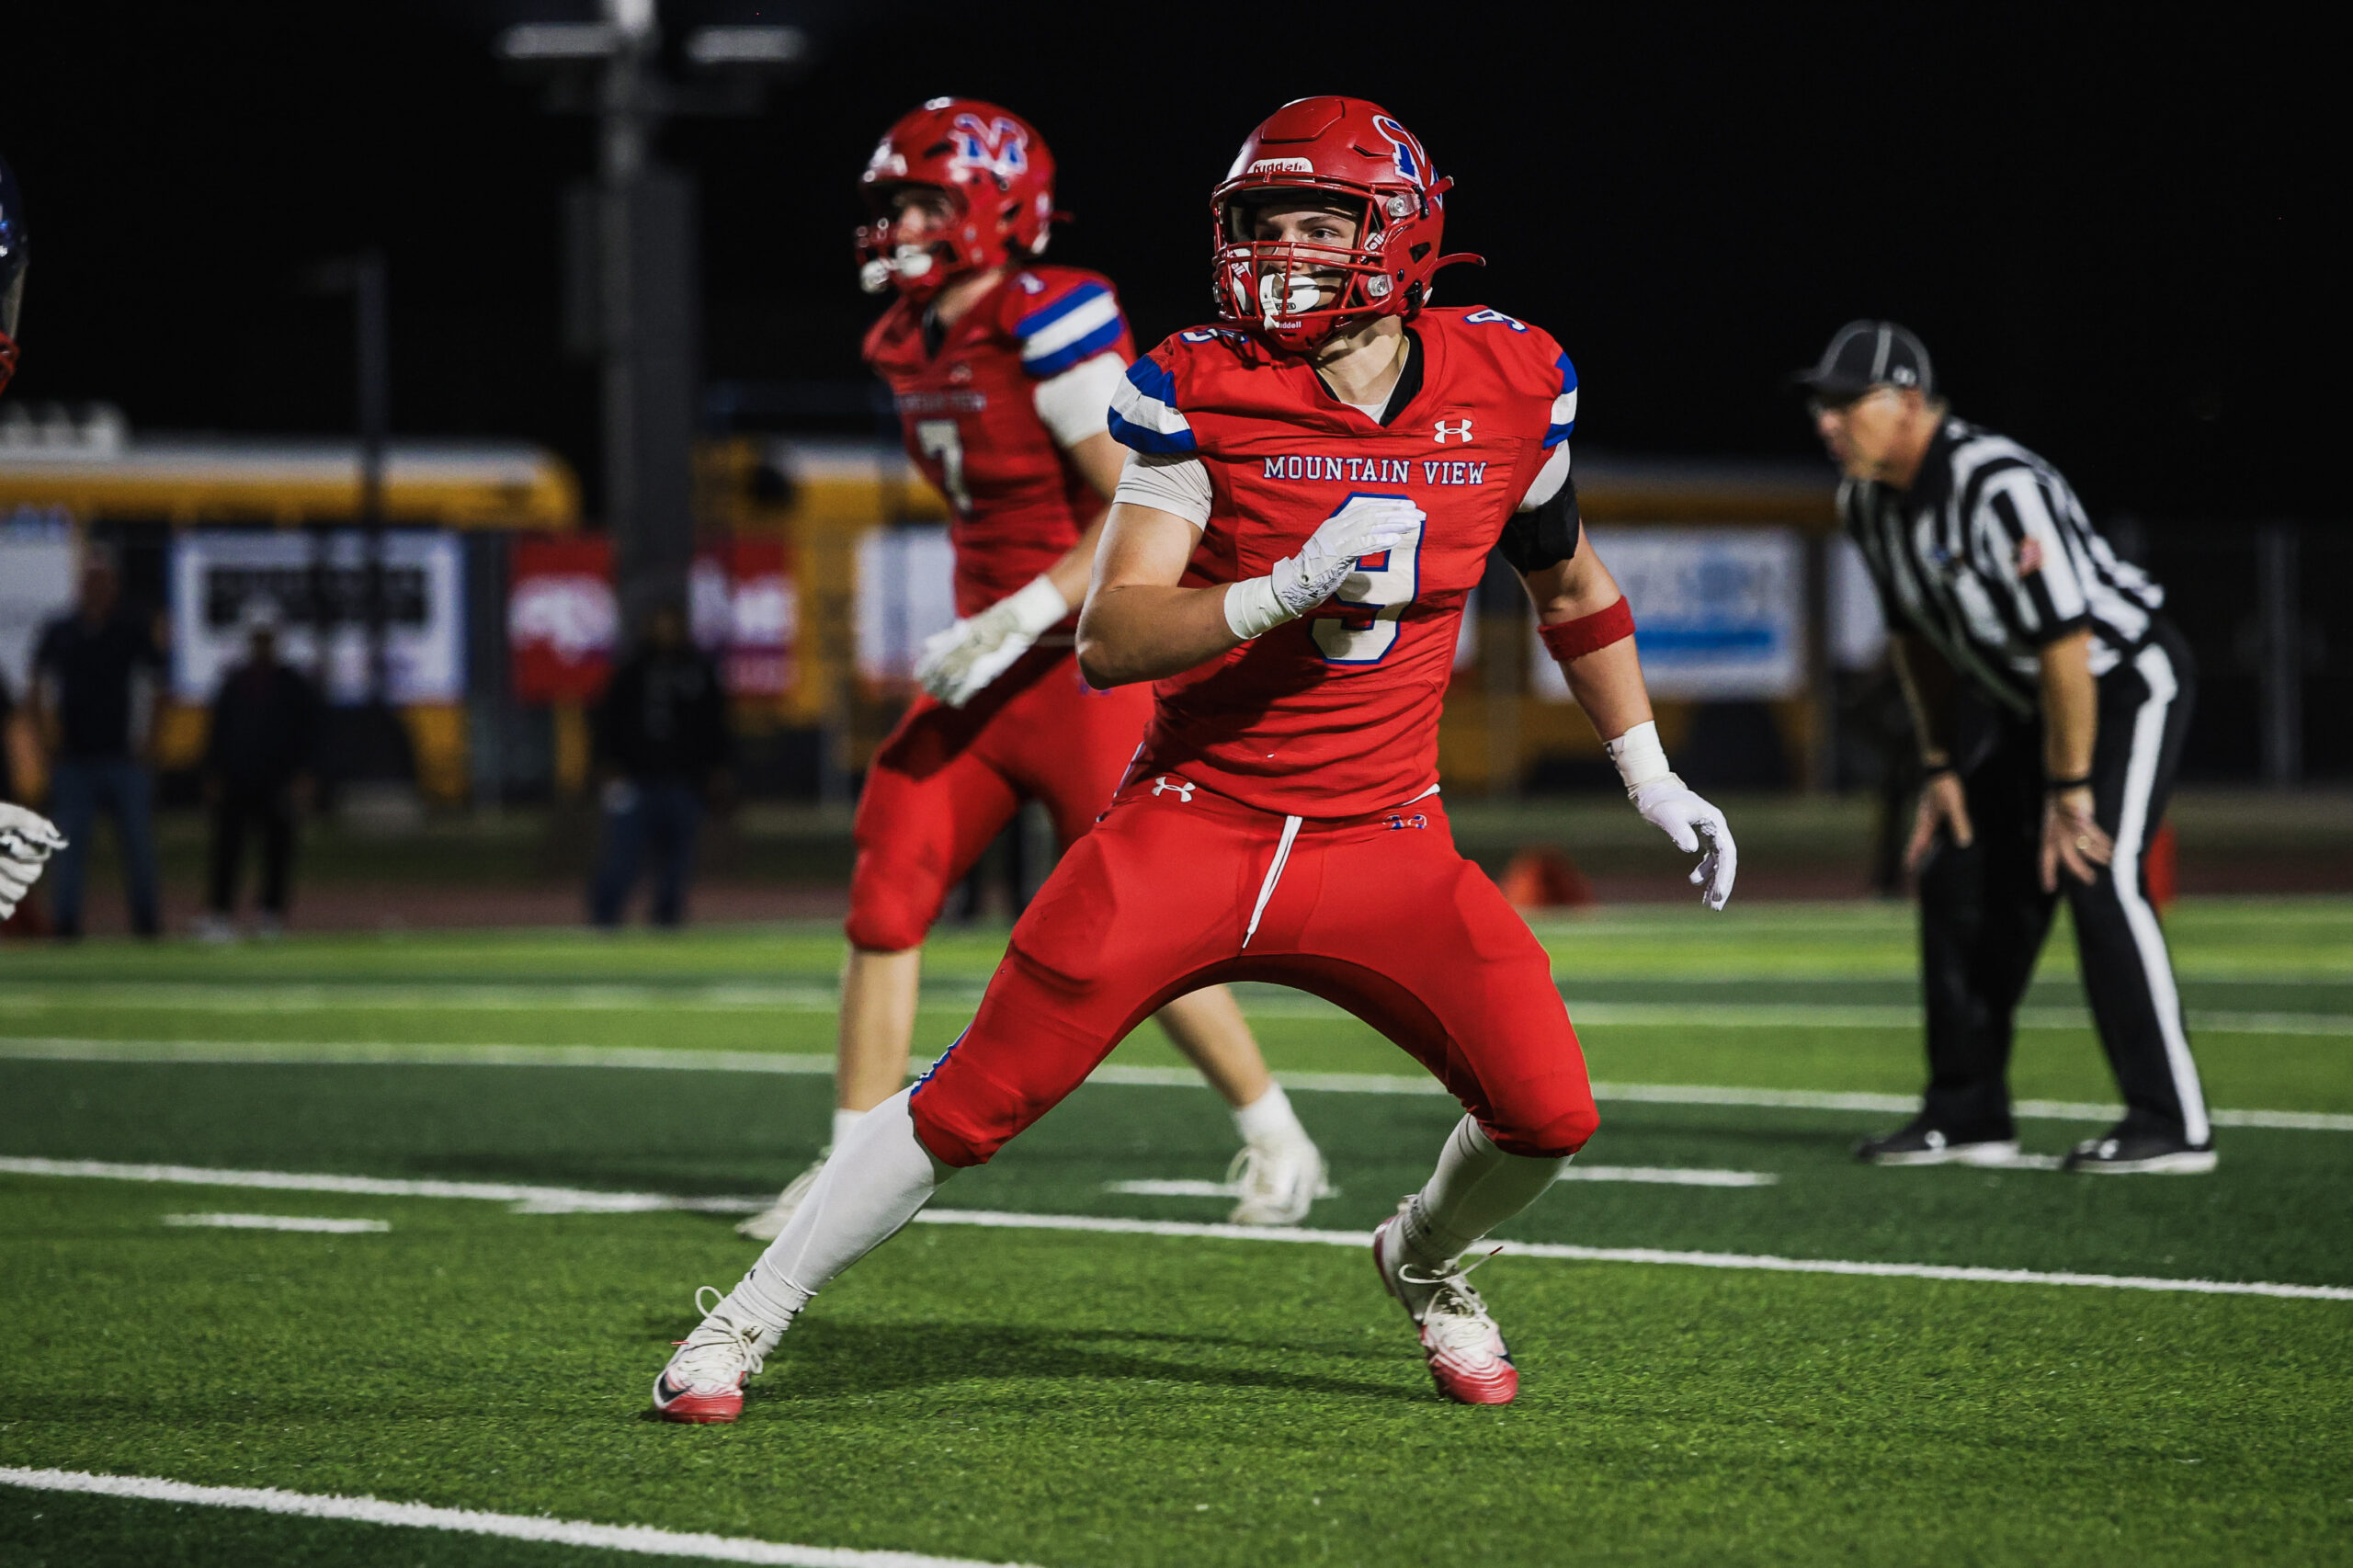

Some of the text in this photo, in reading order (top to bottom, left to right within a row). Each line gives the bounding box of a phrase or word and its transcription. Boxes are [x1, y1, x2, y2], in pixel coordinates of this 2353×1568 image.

[1462, 308, 1529, 334] 9
[915, 419, 974, 515] 7
[1263, 455, 1488, 485] MOUNTAIN VIEW
[1308, 492, 1425, 665] 9
